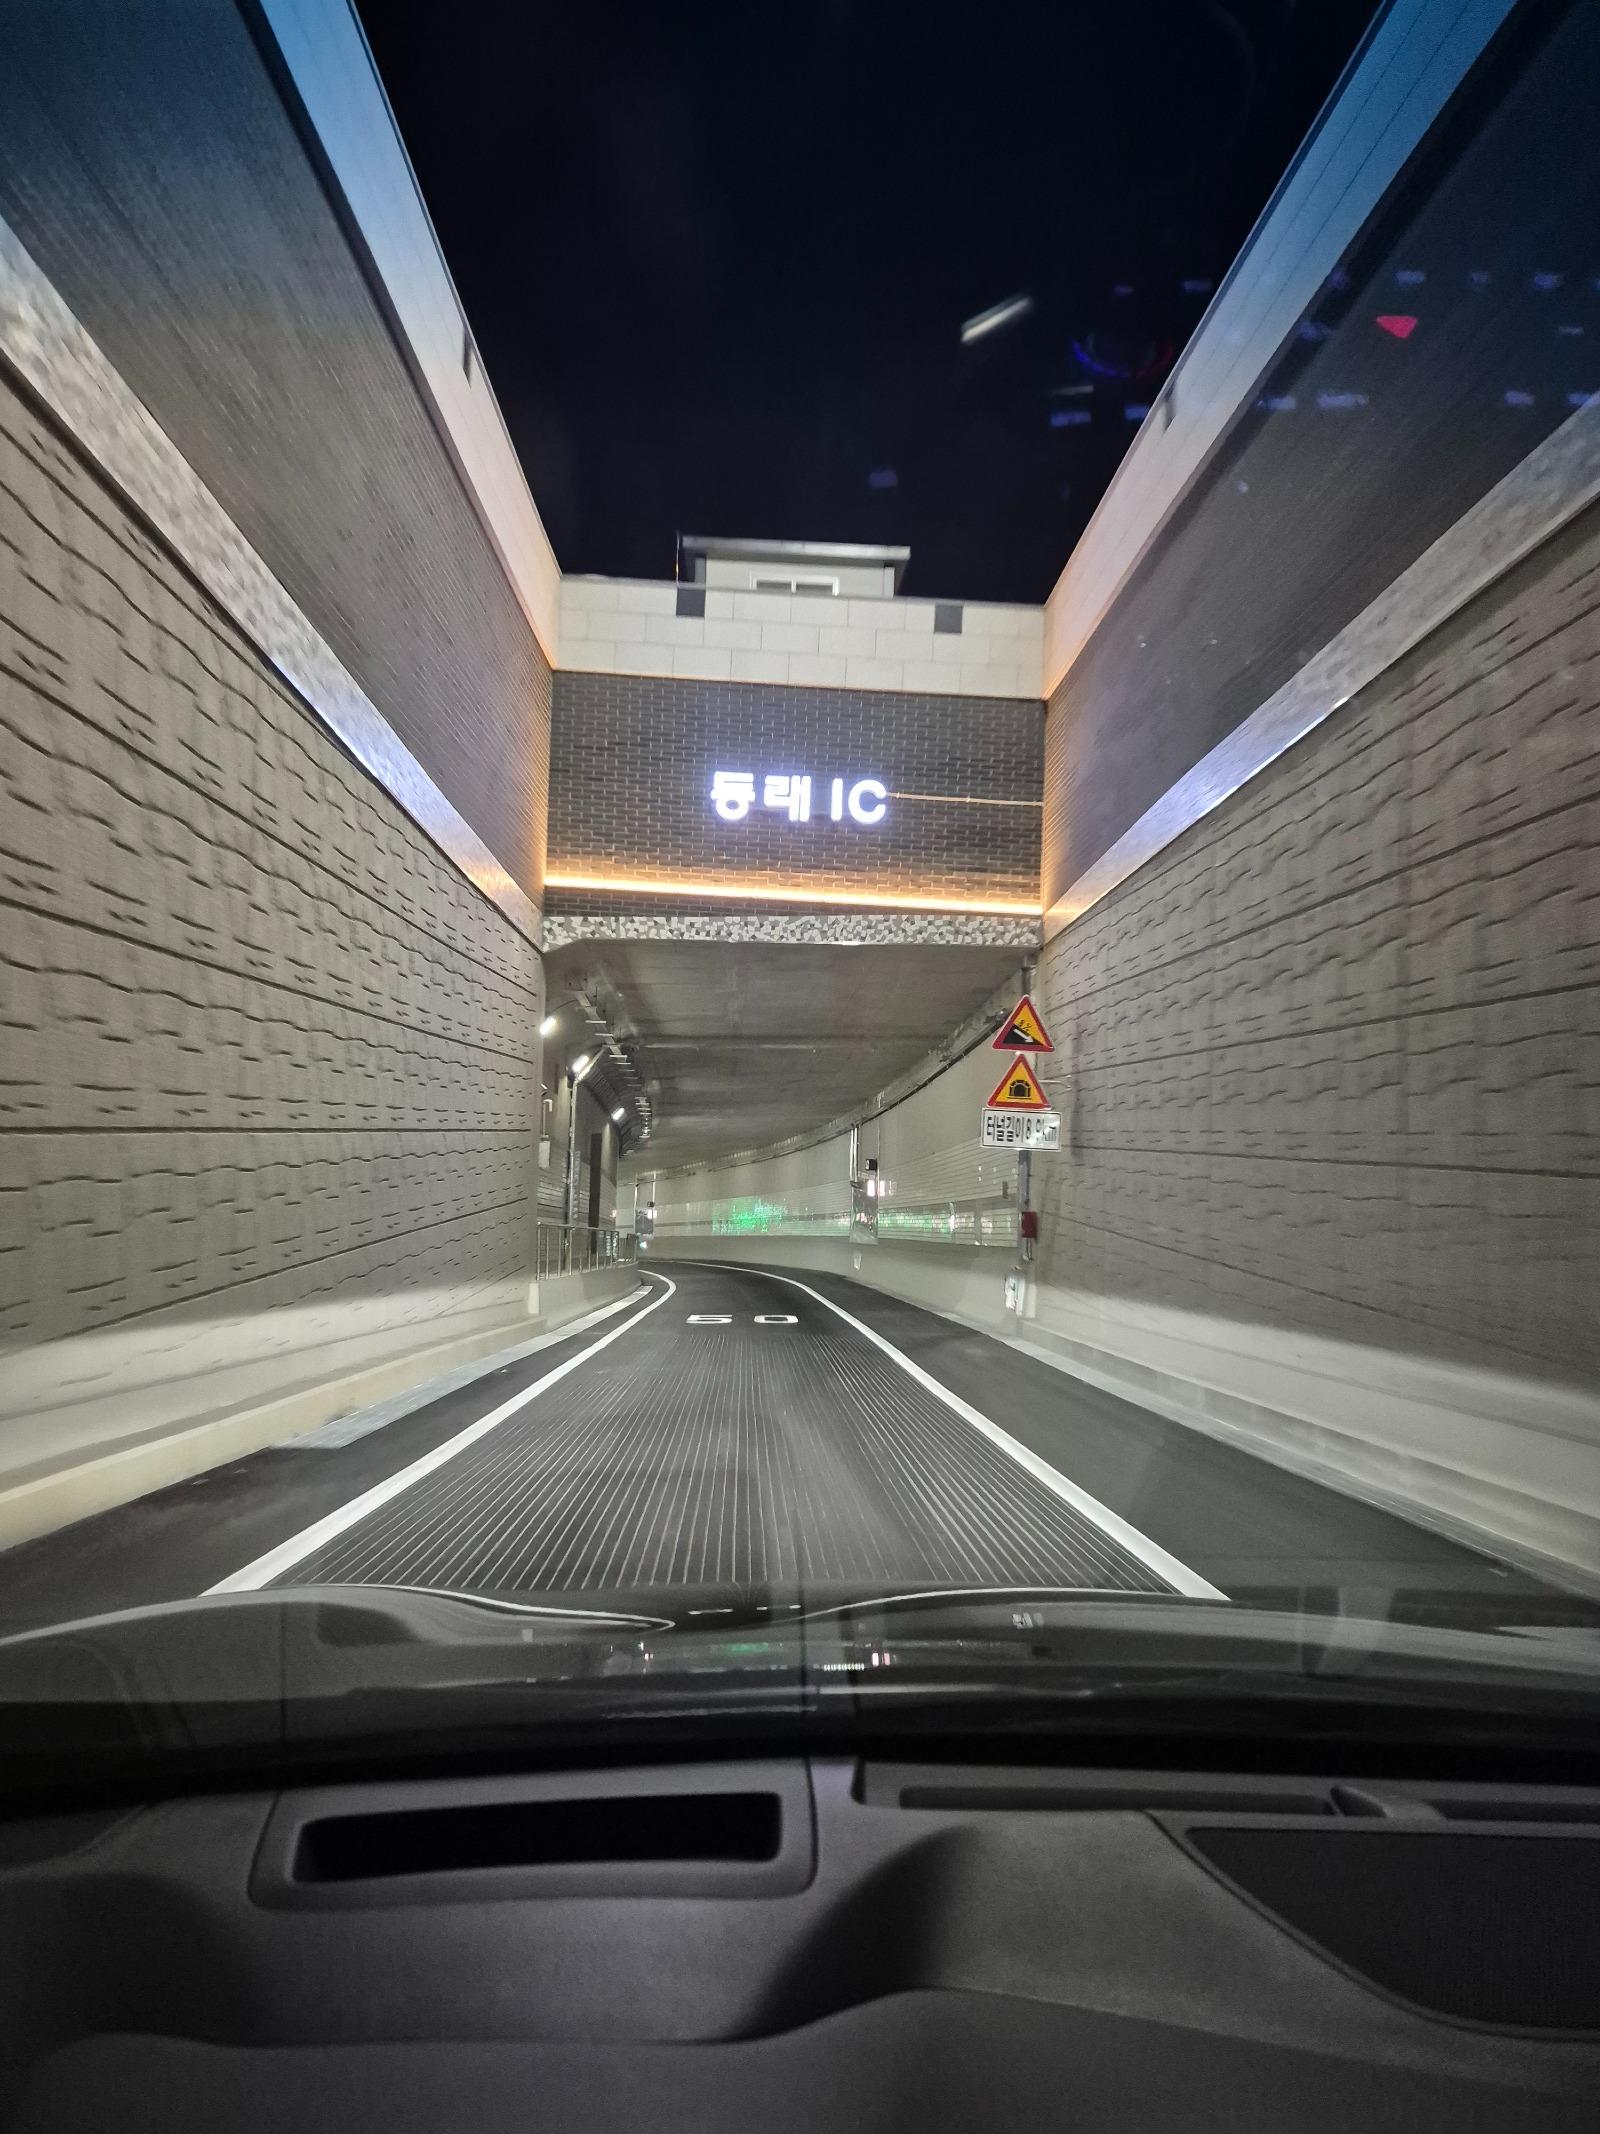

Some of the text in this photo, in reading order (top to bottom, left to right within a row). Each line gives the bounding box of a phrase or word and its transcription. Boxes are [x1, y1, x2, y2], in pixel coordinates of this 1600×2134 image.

[710, 771, 887, 824] 동래 IC
[686, 1314, 799, 1324] 50
